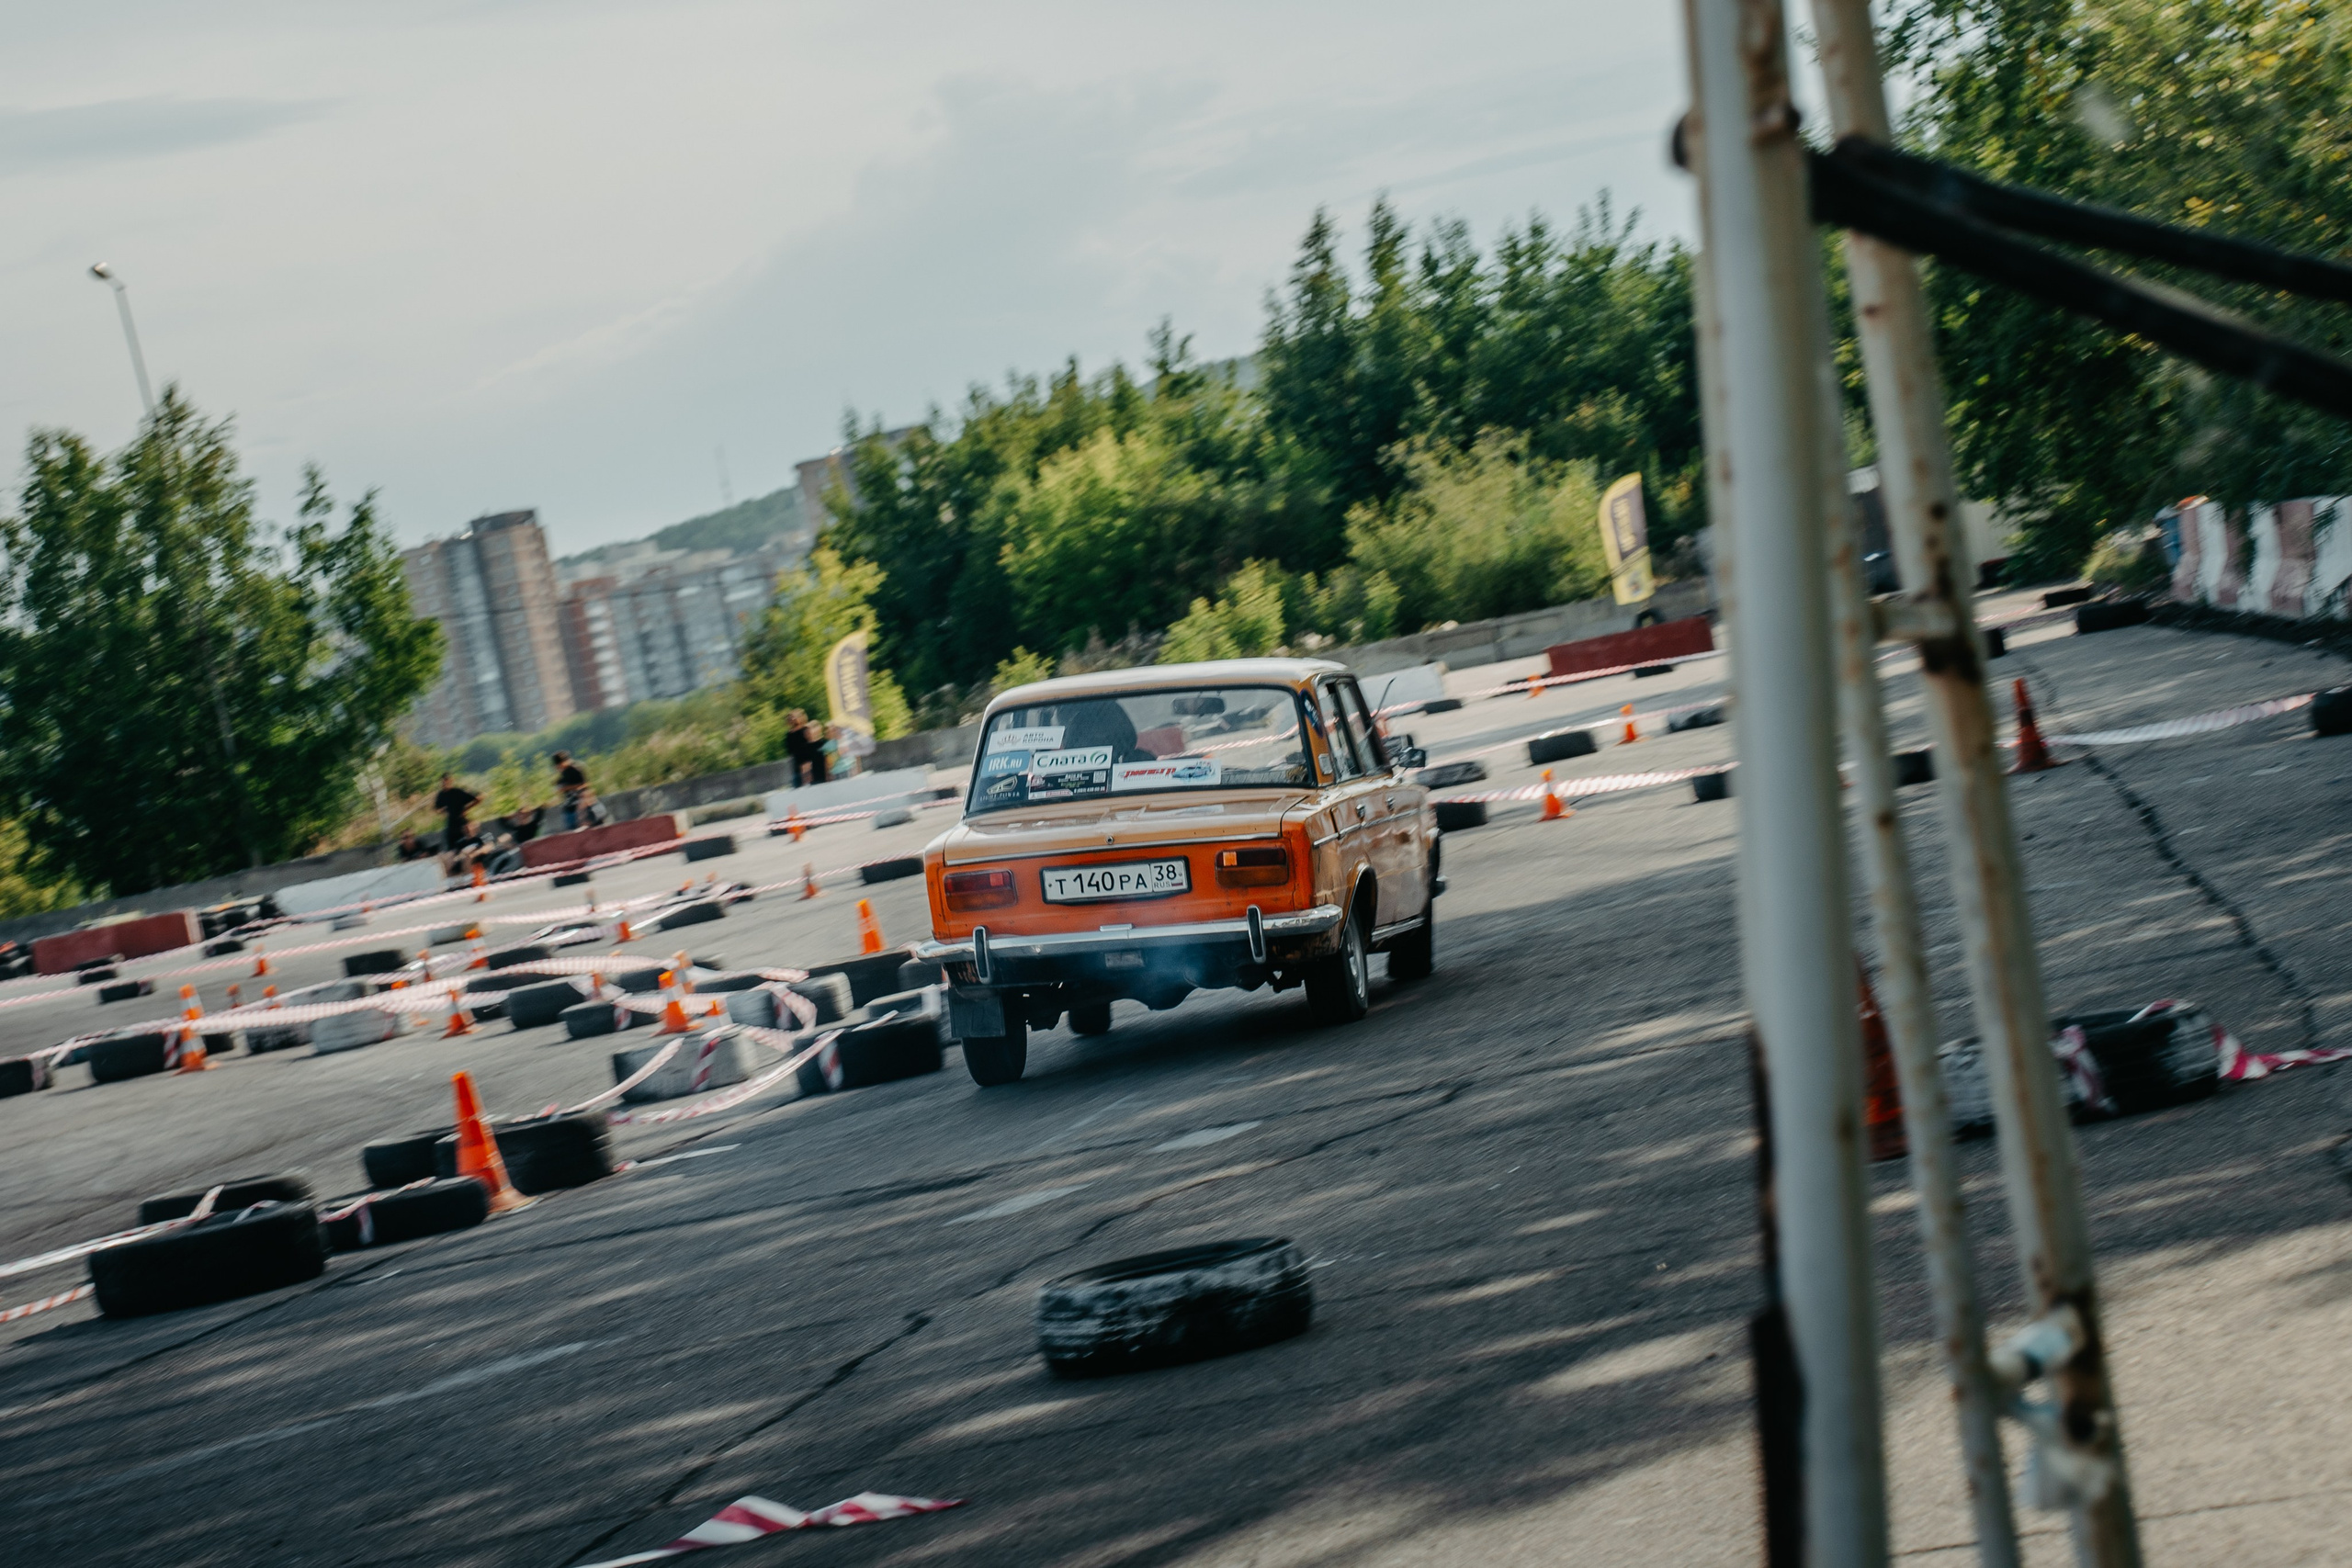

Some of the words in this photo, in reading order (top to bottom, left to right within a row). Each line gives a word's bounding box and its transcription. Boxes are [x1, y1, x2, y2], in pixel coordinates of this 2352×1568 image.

[988, 756, 1023, 772] IRK.RU
[1036, 755, 1087, 768] Слата
[1153, 864, 1177, 882] 38
